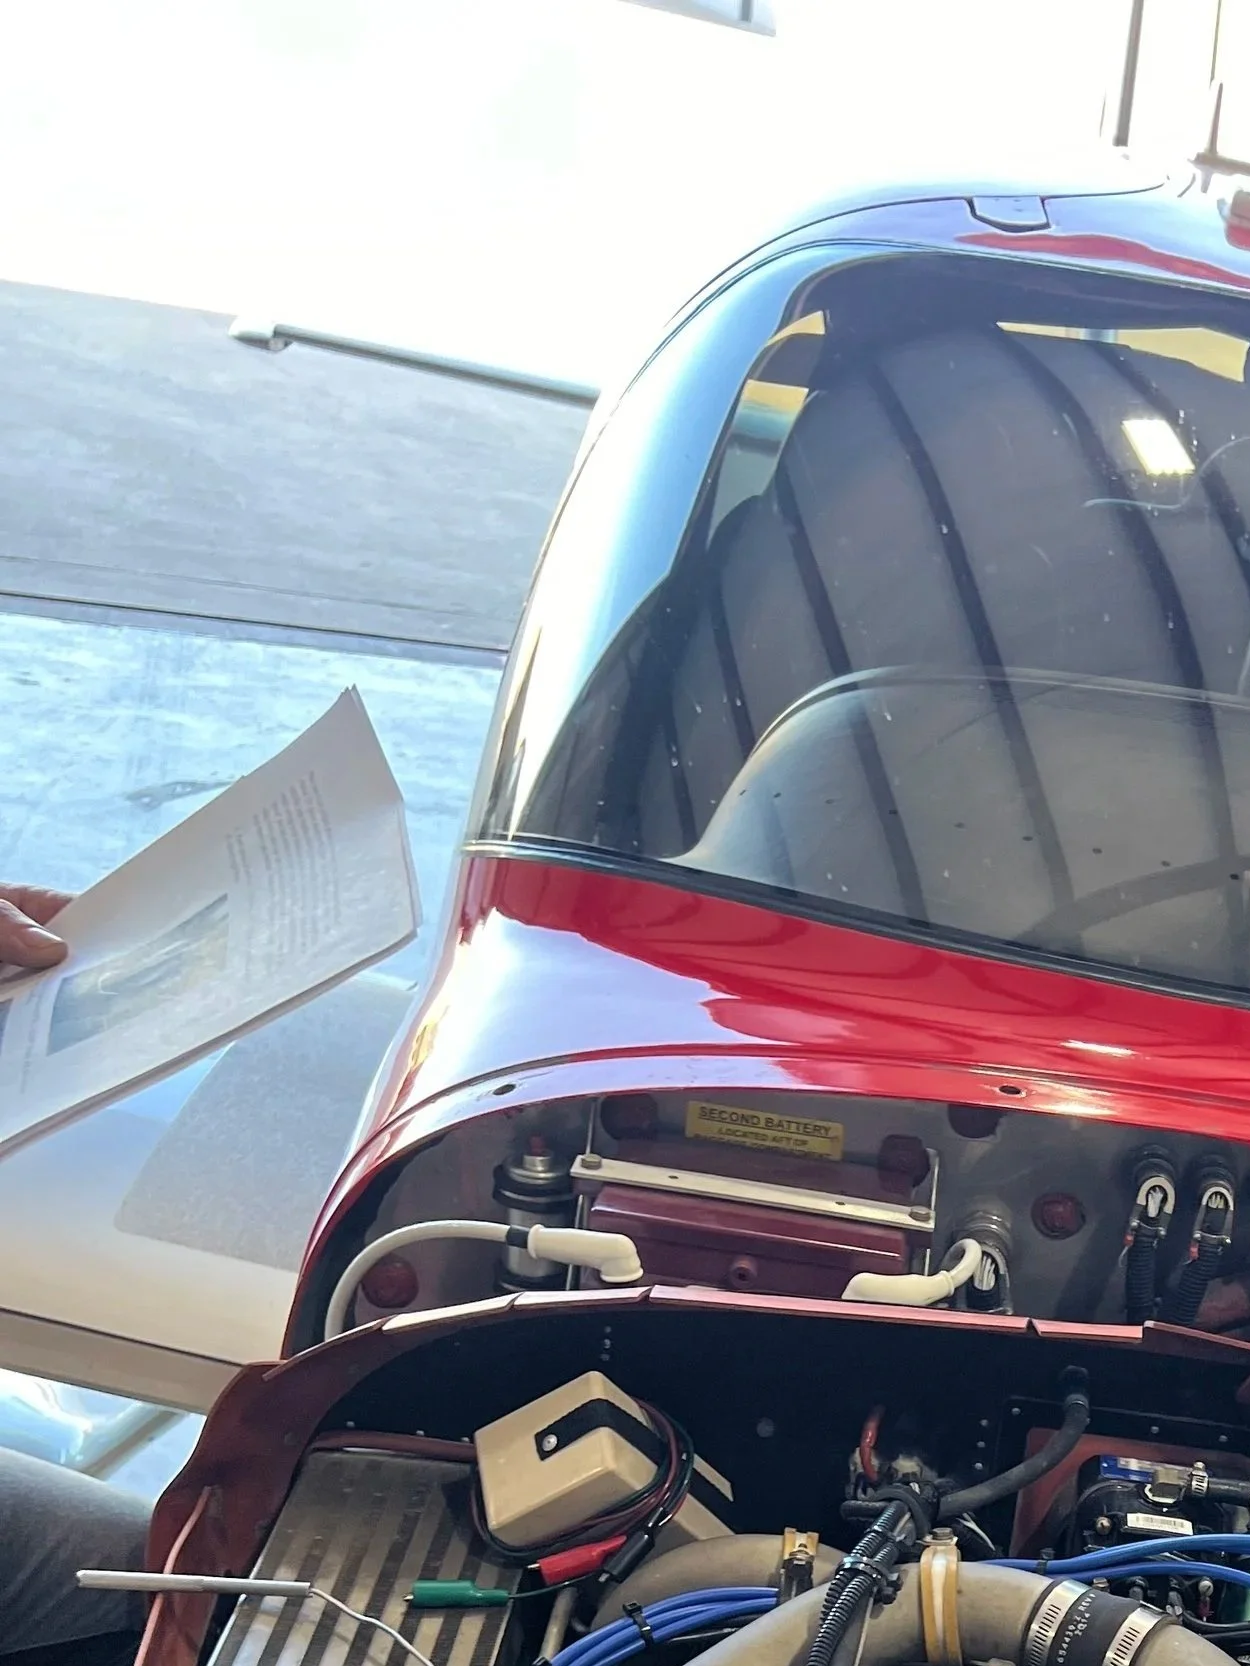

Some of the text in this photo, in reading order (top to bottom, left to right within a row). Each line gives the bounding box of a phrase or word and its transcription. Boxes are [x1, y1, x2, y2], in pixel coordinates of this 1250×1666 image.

[699, 1106, 831, 1136] SECOND BATTERY
[1077, 1597, 1093, 1612] REV
